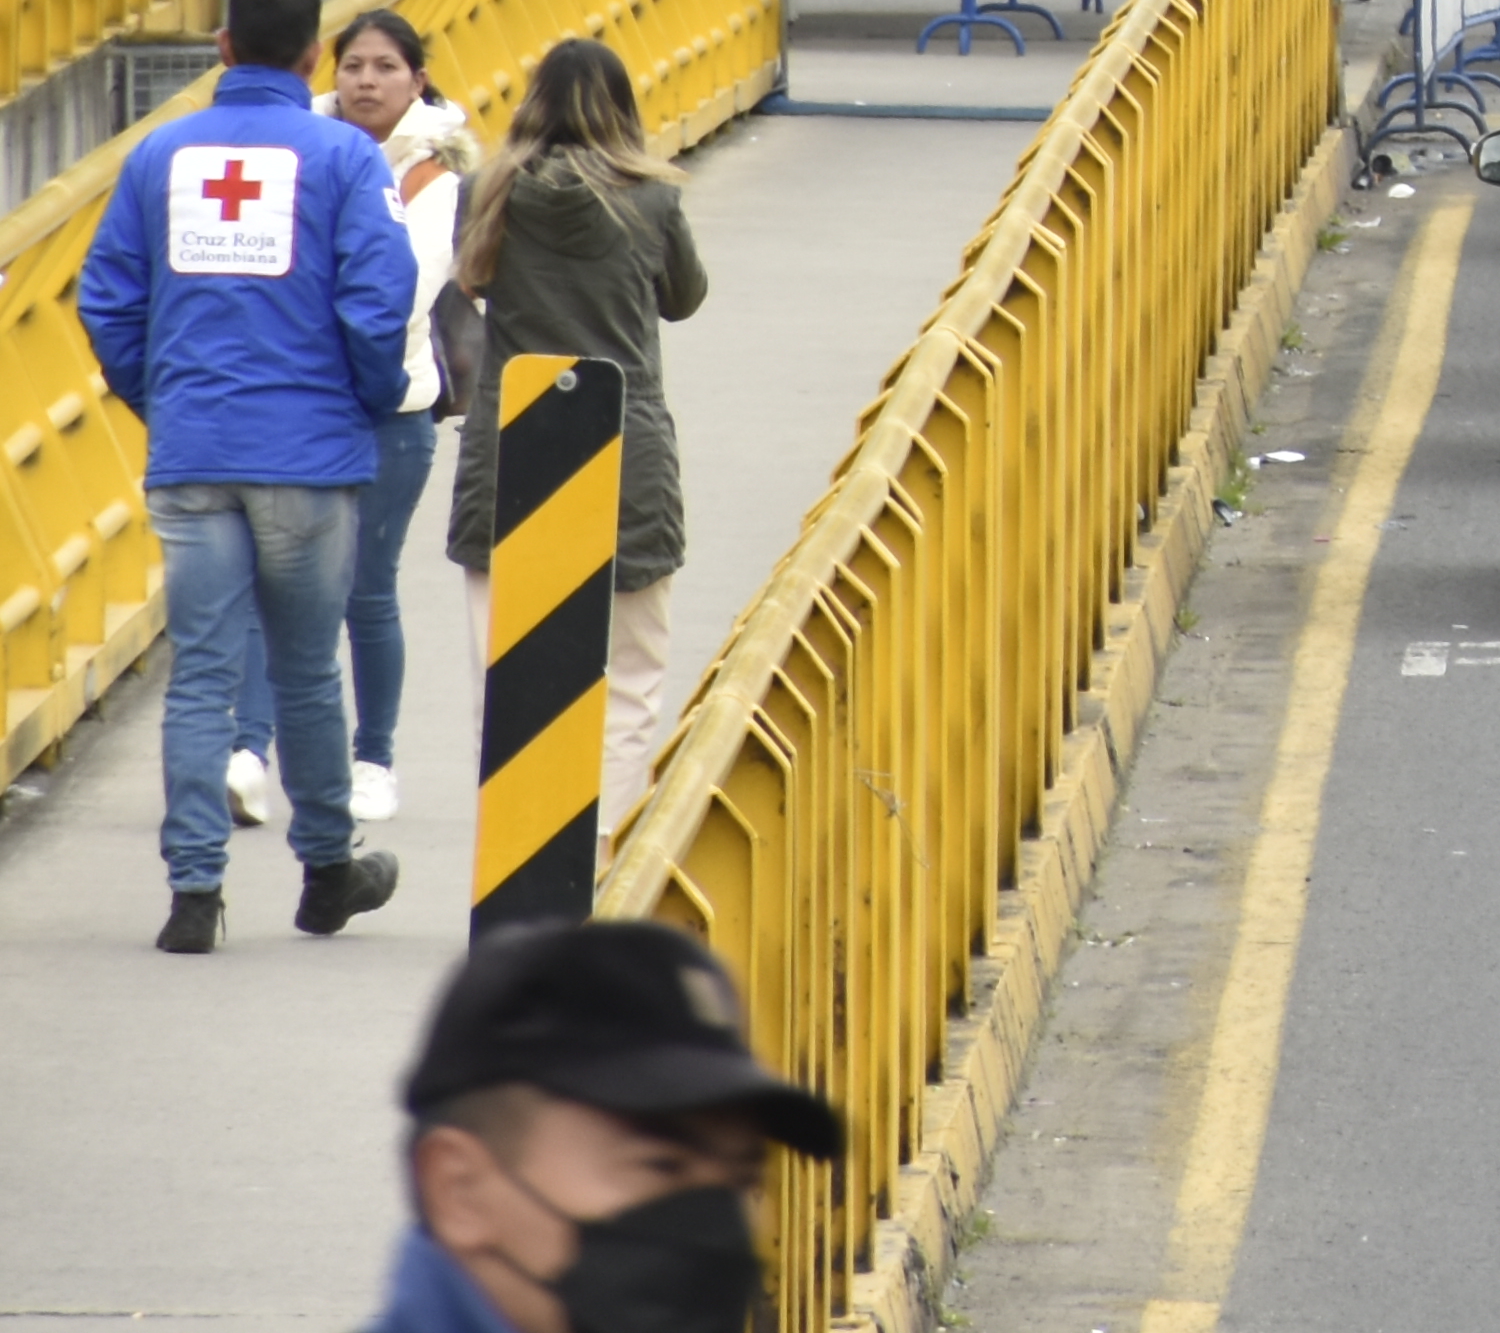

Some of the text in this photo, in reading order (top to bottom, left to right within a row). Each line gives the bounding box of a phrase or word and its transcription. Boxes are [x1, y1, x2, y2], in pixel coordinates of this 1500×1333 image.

[181, 230, 276, 252] Cruz Roja
[179, 249, 278, 264] Colombiana
